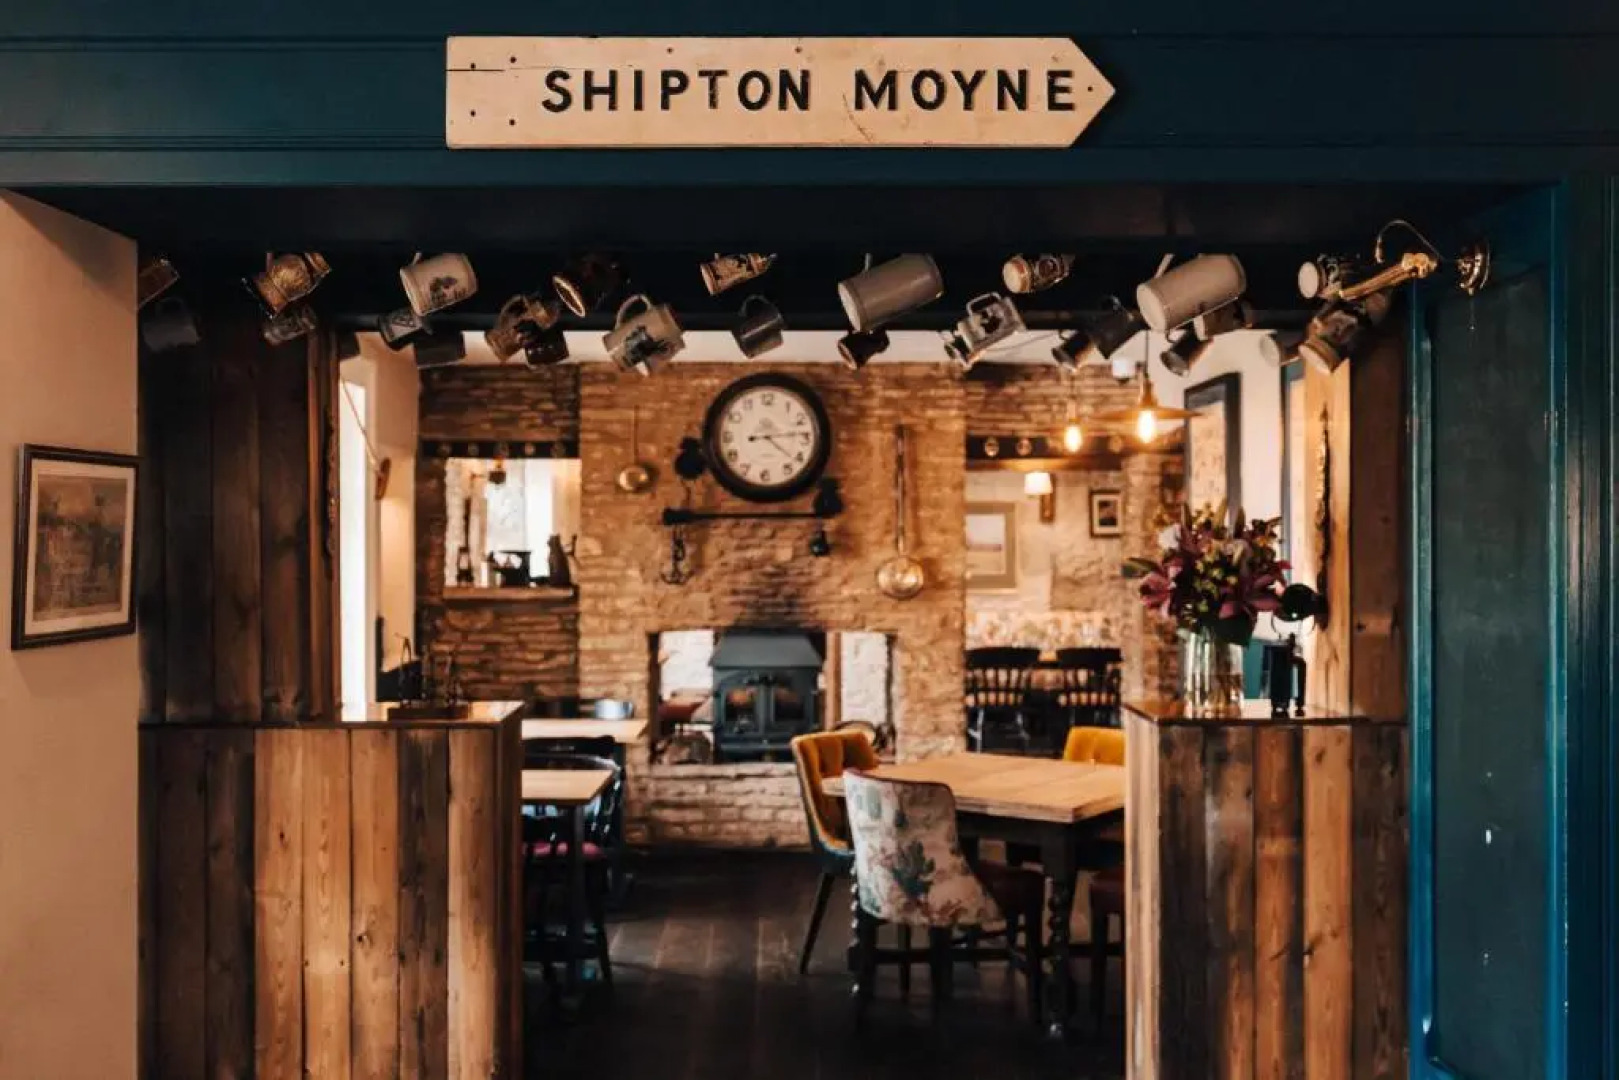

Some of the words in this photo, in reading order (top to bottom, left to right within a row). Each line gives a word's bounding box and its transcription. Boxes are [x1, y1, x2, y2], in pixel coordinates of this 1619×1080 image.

[542, 70, 810, 112] SHIPTON
[855, 70, 1075, 112] MOYNE
[761, 393, 775, 406] 12
[796, 412, 805, 426] 2
[740, 463, 751, 476] 7
